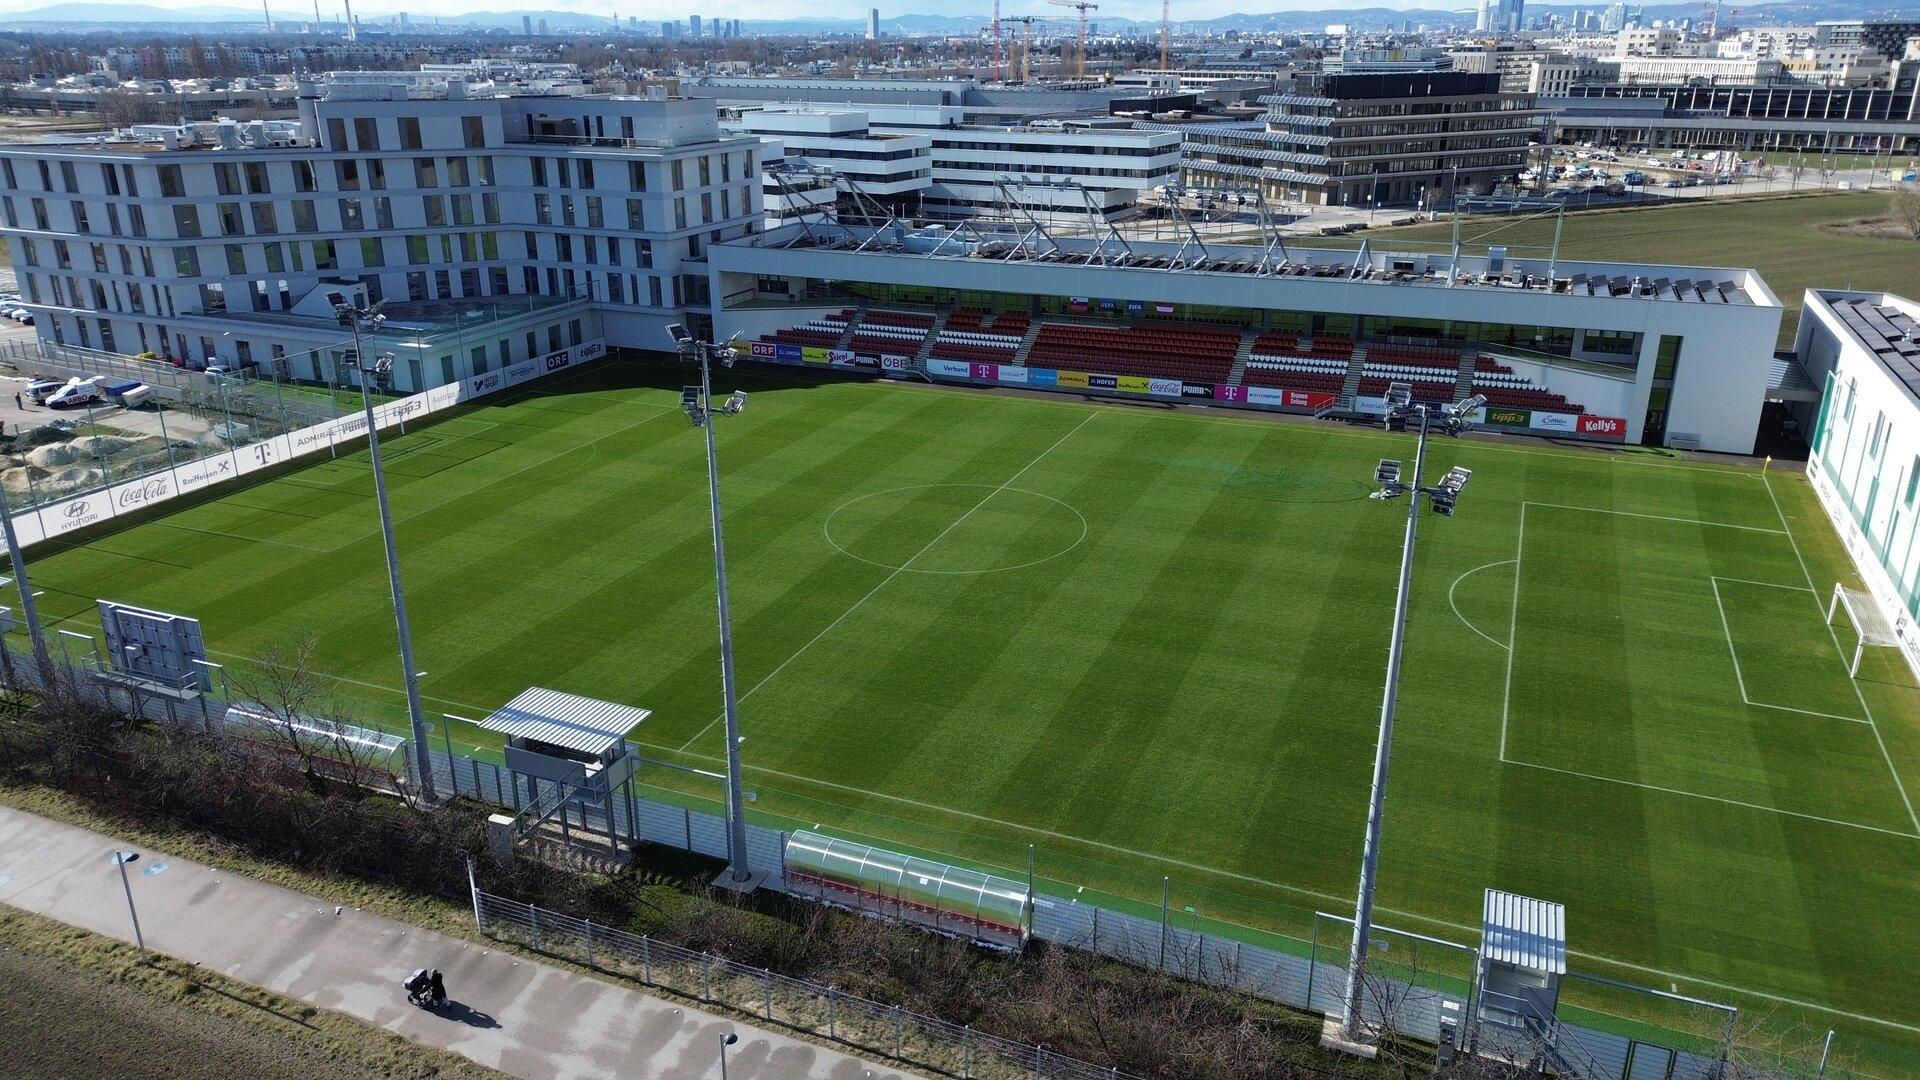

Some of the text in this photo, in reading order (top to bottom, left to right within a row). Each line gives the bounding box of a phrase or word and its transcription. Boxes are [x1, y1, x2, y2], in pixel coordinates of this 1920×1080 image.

[753, 345, 774, 355] ORF
[547, 354, 568, 368] ORF
[856, 355, 874, 364] PUMA
[943, 365, 968, 373] Verbund
[483, 375, 499, 384] INTER
[1096, 378, 1116, 386] HOFER
[484, 381, 499, 390] SPORT
[1182, 386, 1204, 395] PUMA
[68, 394, 88, 405] ARBO
[1585, 420, 1617, 432] Kelly's
[182, 470, 218, 487] Raiffeisen
[61, 513, 99, 531] HYUNDAI
